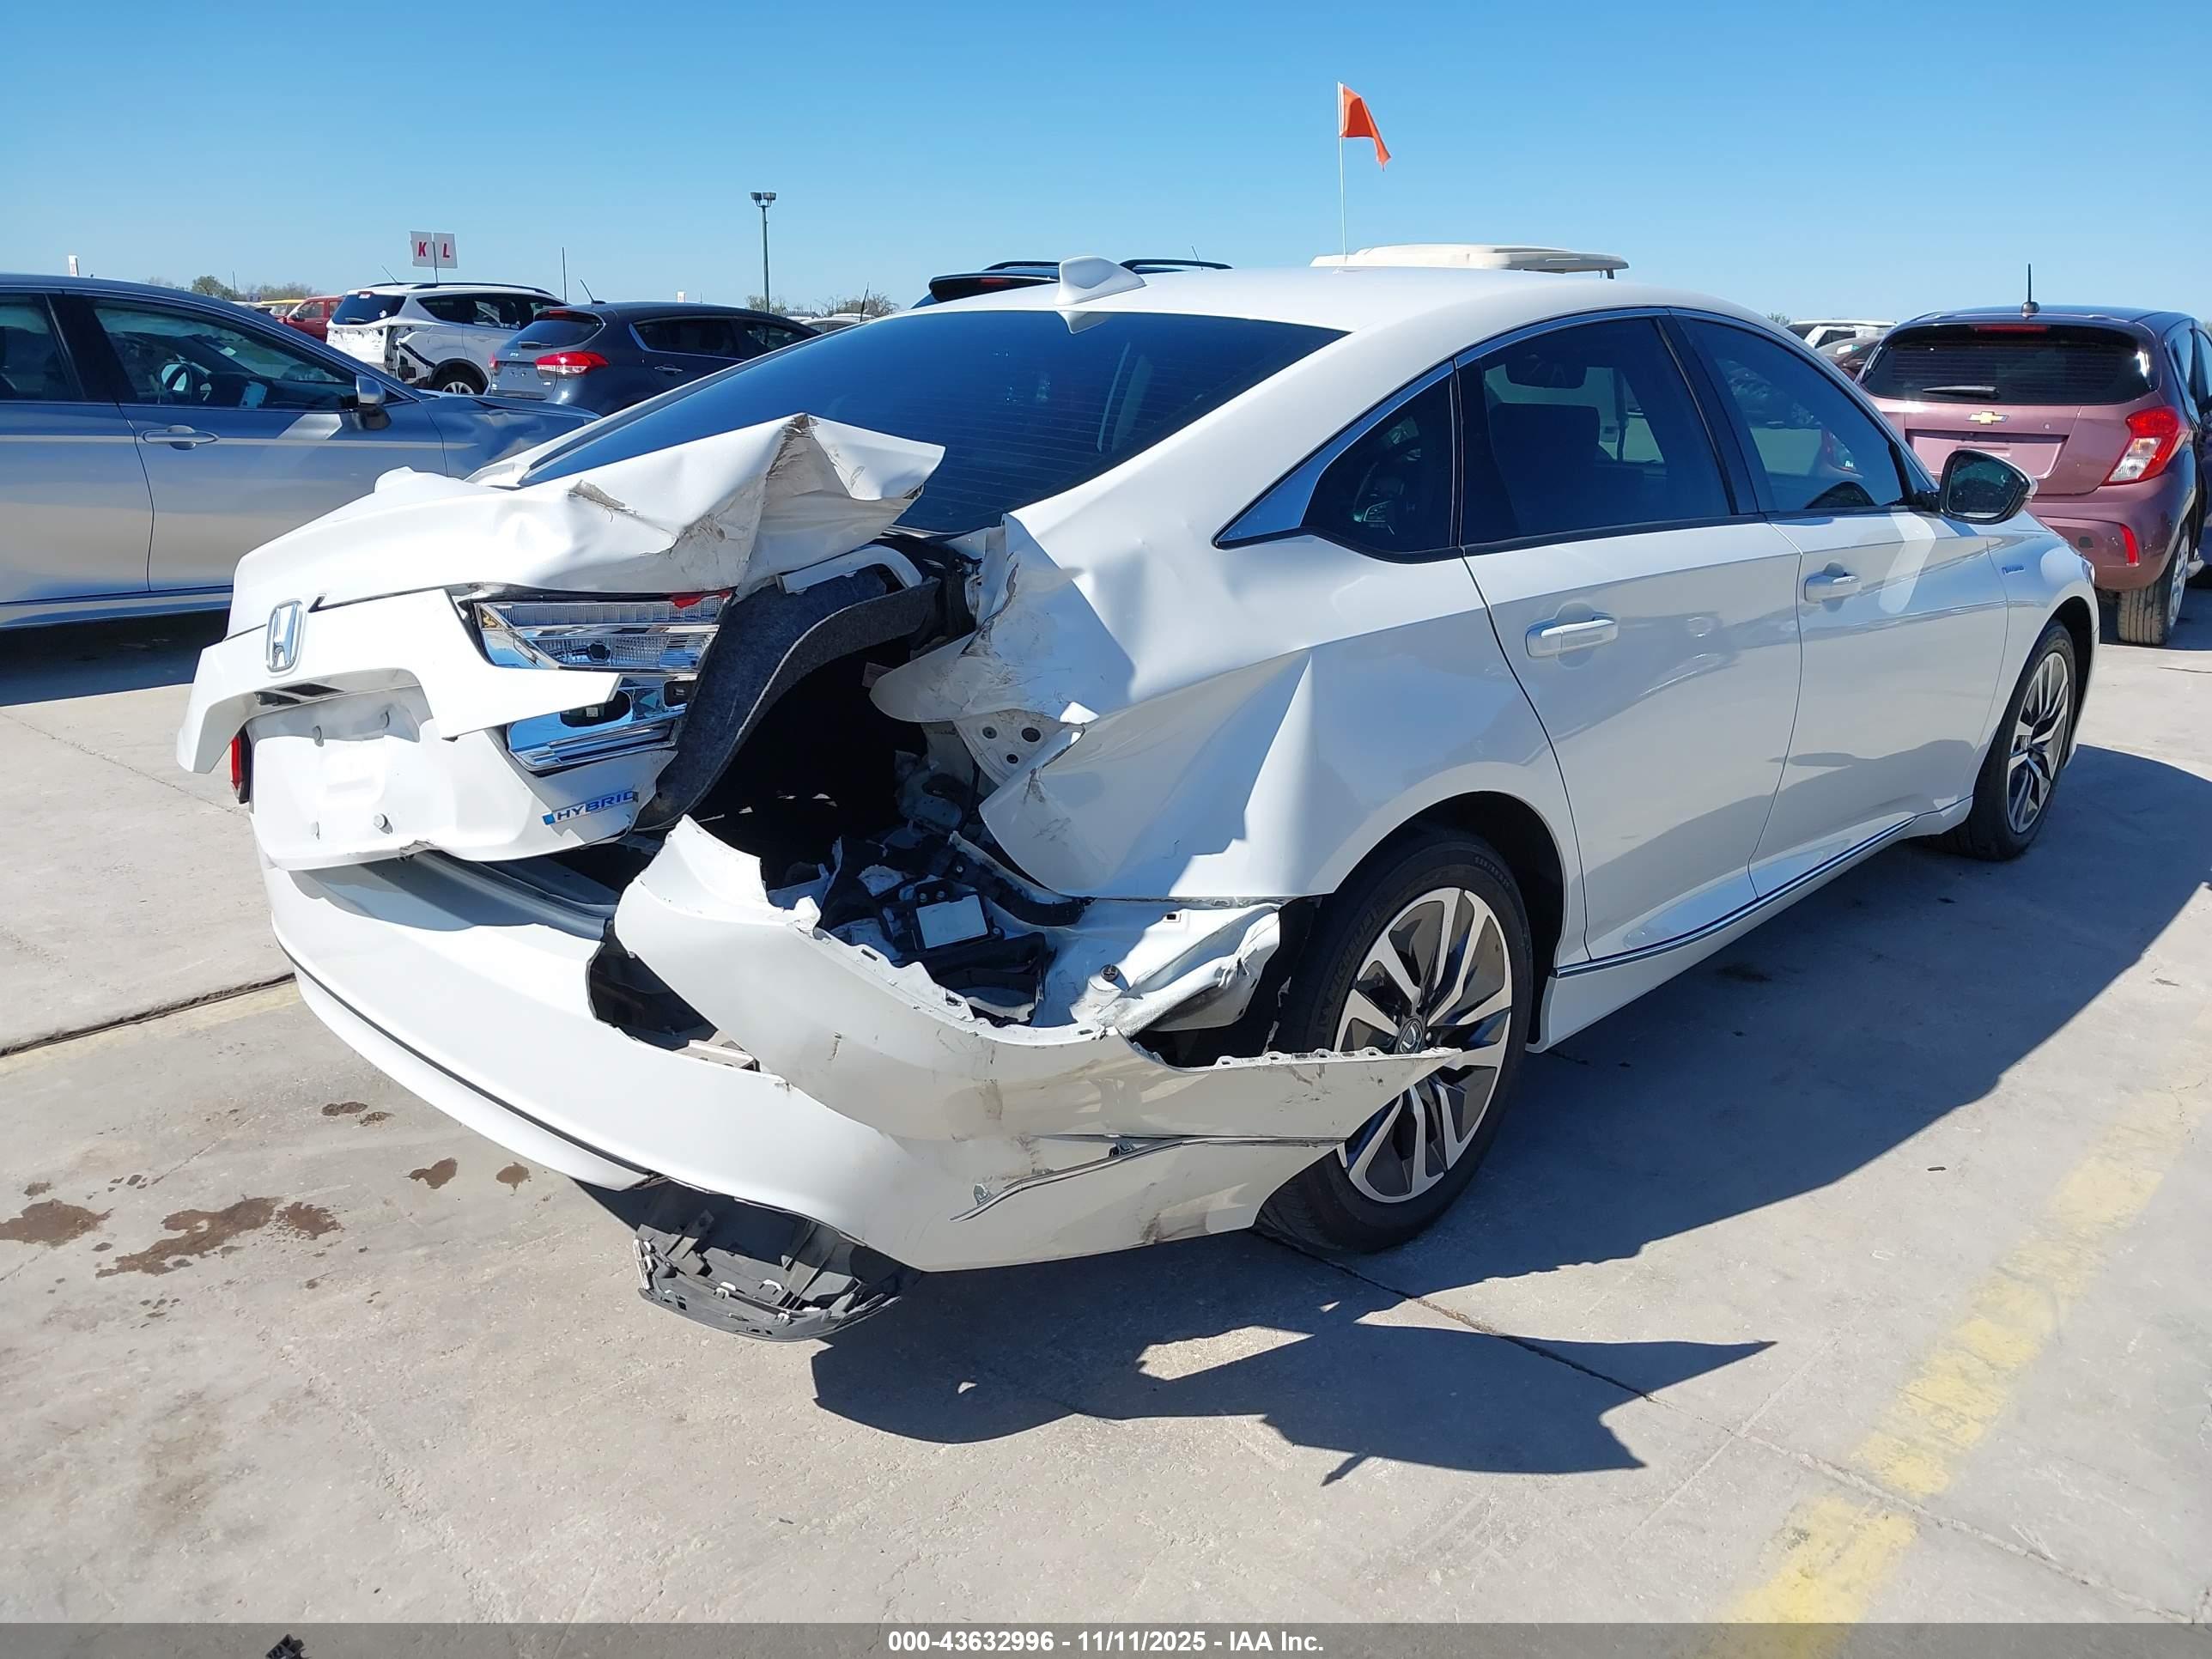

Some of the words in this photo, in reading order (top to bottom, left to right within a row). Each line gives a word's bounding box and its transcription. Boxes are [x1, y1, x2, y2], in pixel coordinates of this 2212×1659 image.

[417, 241, 428, 258] K
[441, 242, 451, 258] L
[556, 789, 638, 821] HYBRID
